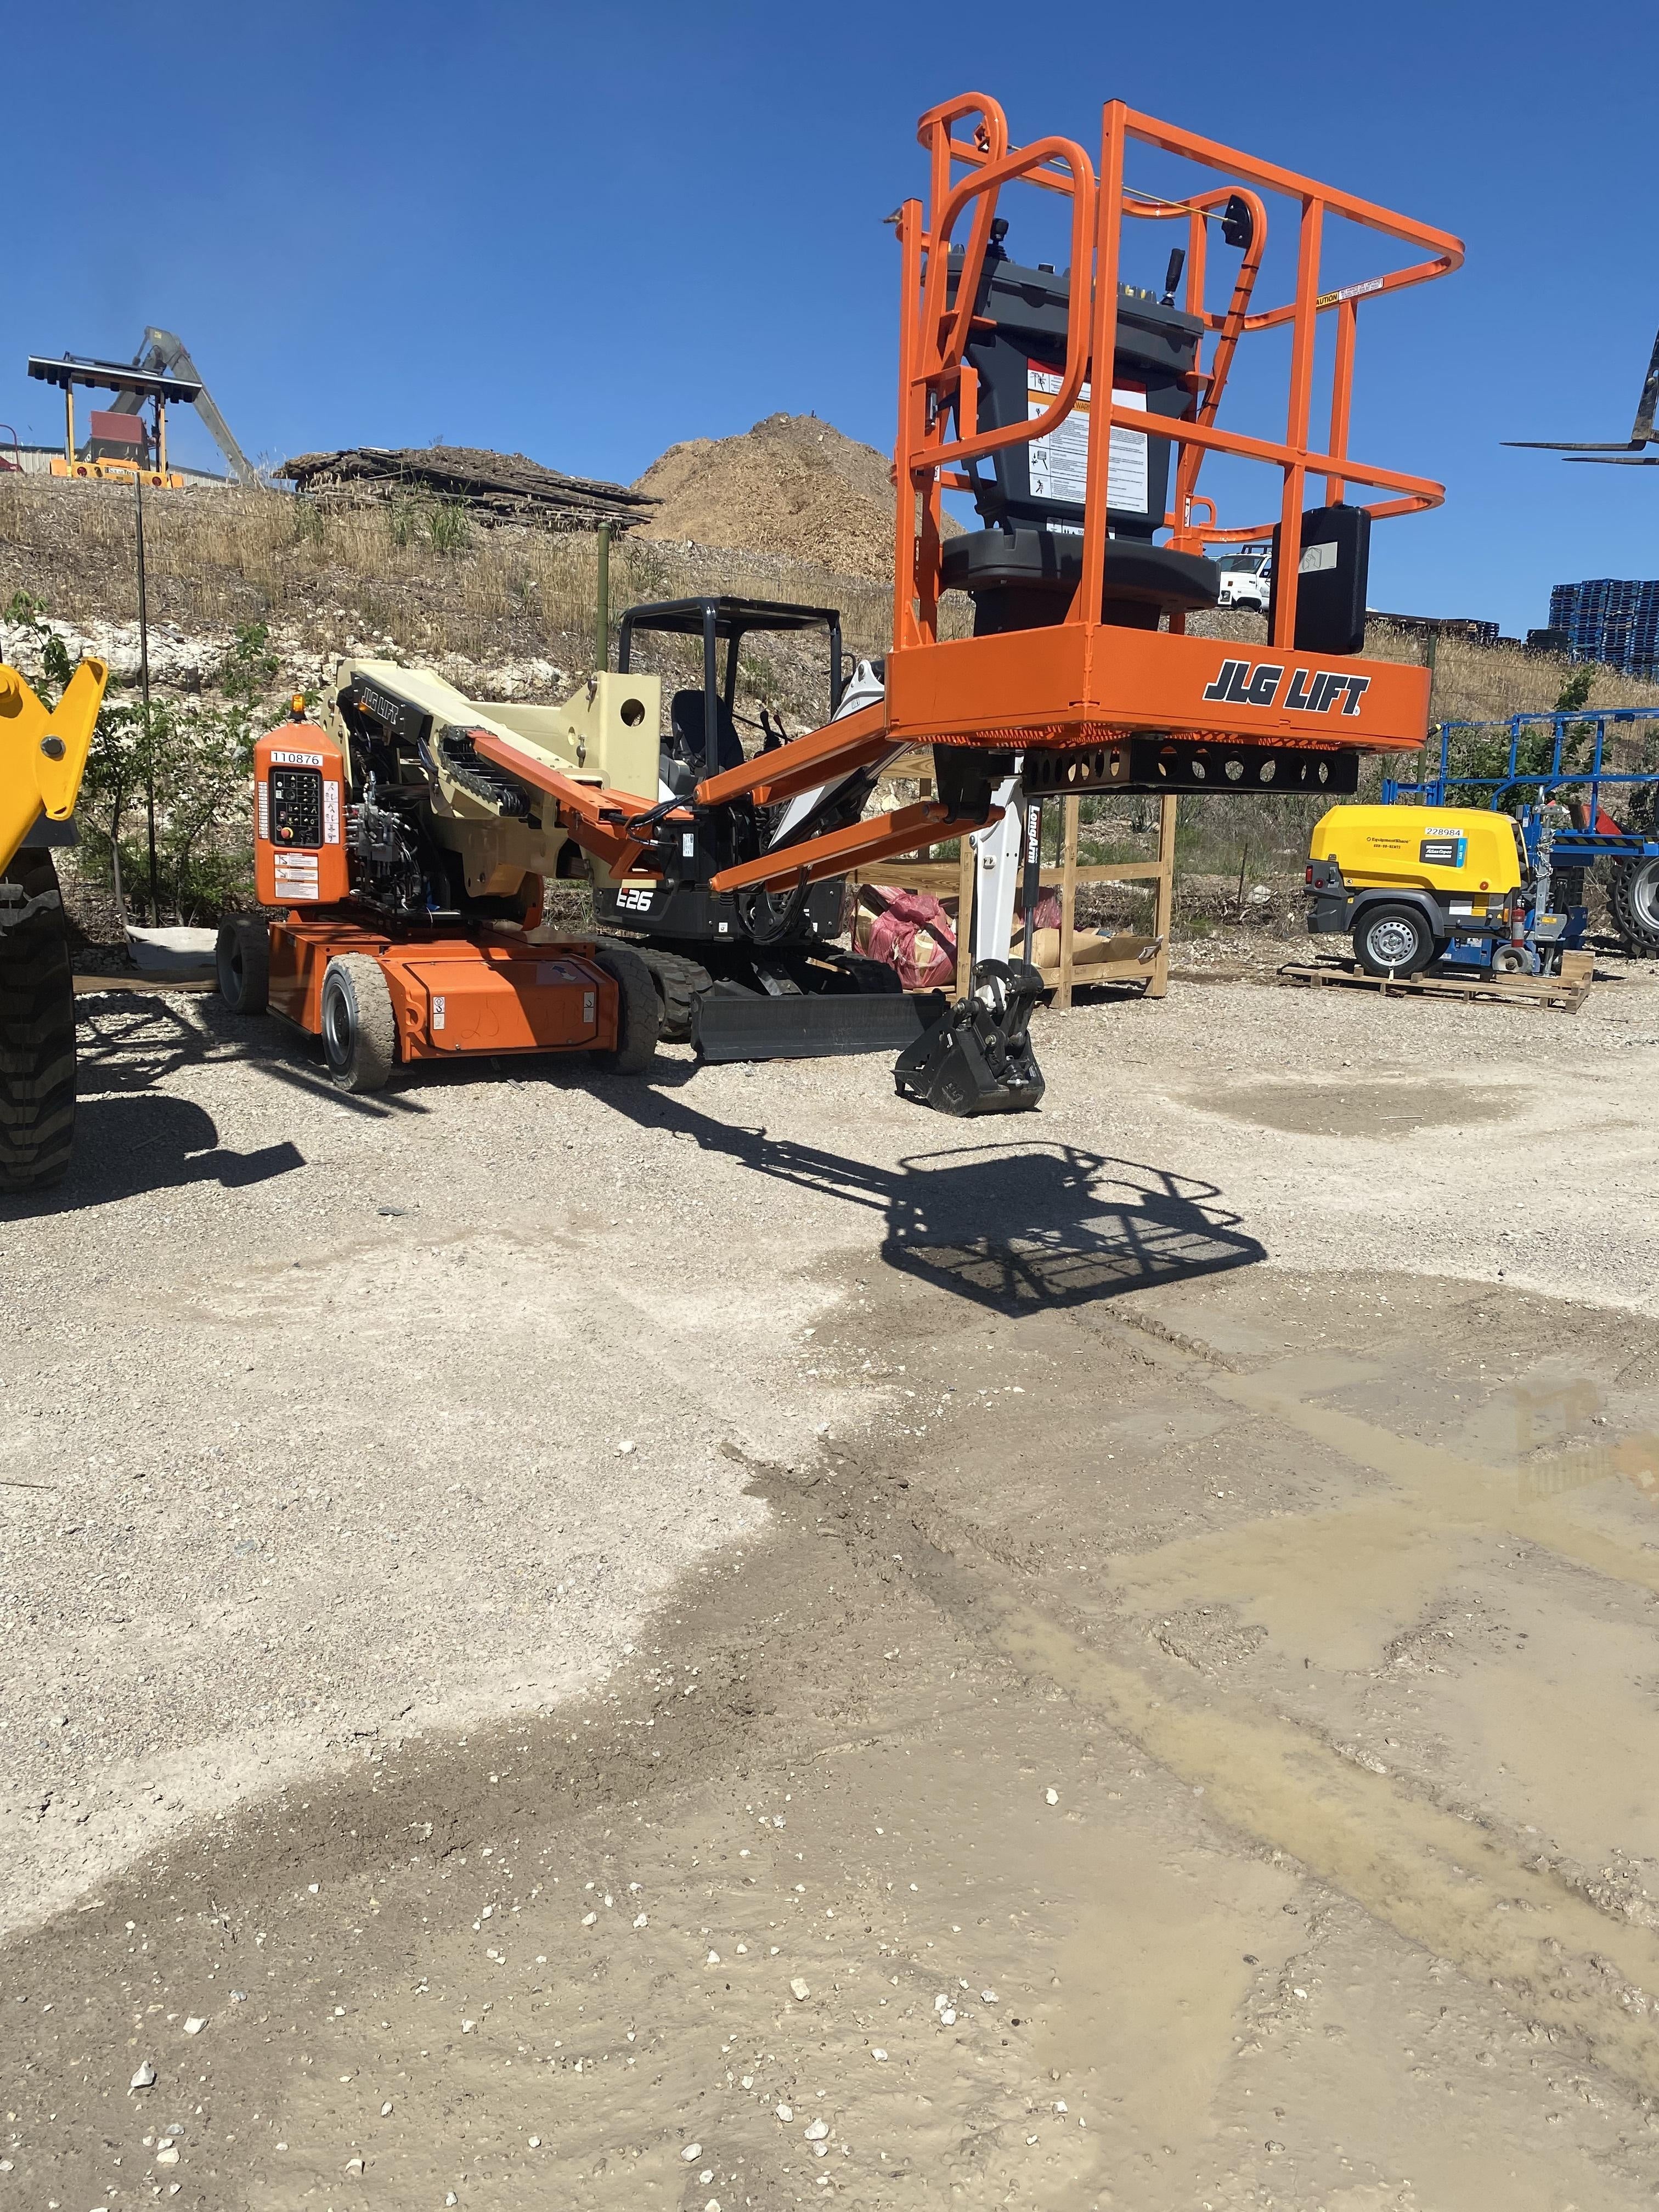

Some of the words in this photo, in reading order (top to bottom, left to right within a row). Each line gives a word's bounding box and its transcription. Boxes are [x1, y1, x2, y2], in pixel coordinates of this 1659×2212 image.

[1317, 294, 1338, 305] AUTION
[1202, 658, 1285, 707] JLG
[1283, 667, 1372, 716] LIFT
[361, 686, 379, 712] JLG
[376, 696, 399, 725] LIFT
[273, 752, 319, 765] 110876
[1028, 804, 1040, 864] LongArm
[1426, 828, 1460, 836] 228984
[616, 887, 654, 911] E26
